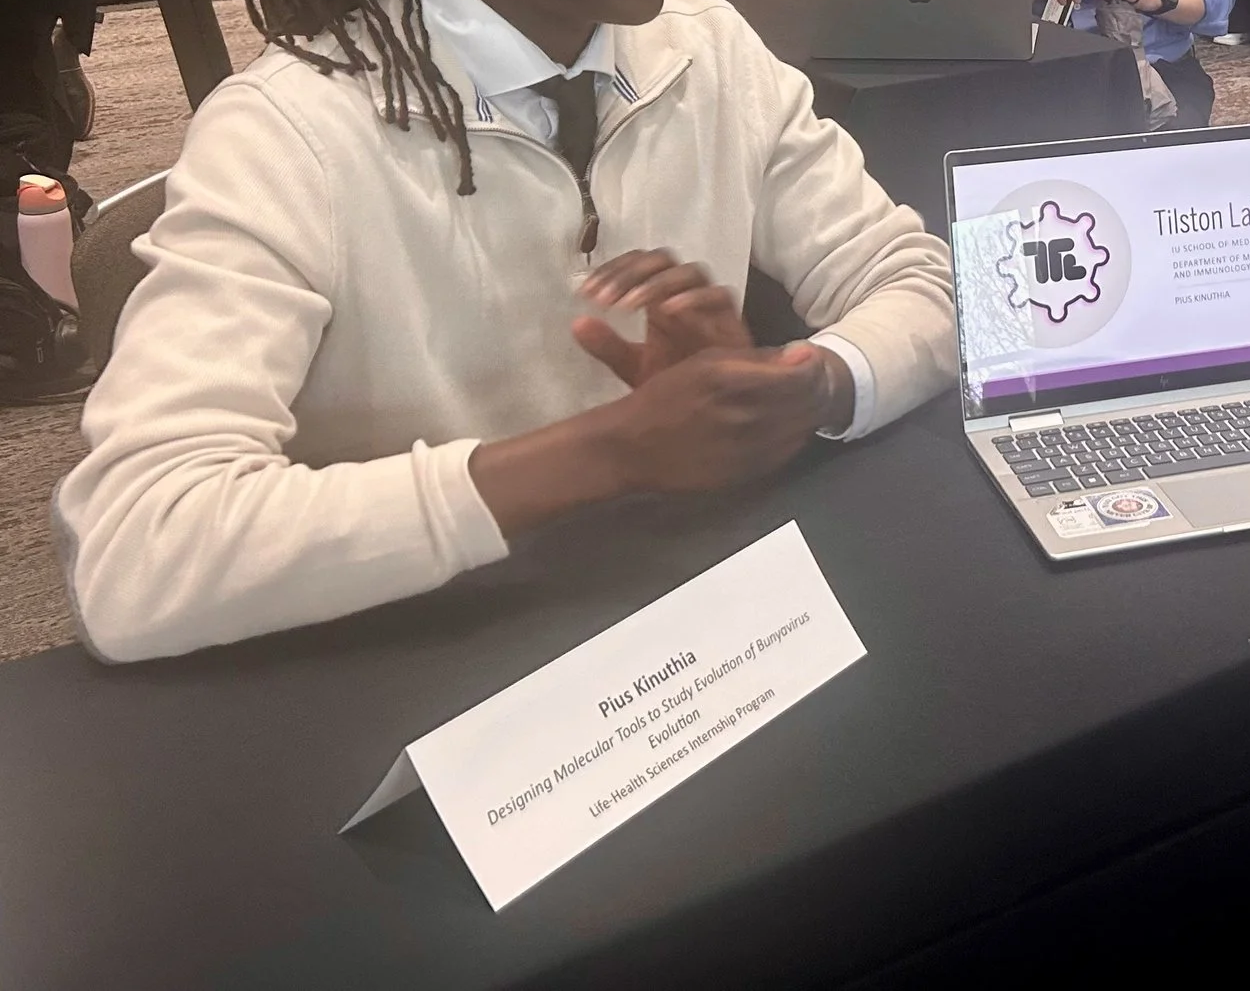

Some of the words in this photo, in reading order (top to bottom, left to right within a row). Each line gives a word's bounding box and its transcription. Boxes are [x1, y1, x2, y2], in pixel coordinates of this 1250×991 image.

[1153, 207, 1223, 236] Tilston
[1171, 245, 1181, 254] IU
[1183, 241, 1216, 253] SCHOOL
[1218, 240, 1228, 249] OF
[1172, 256, 1227, 270] DEPARTMENT
[1229, 254, 1240, 263] OF
[1173, 270, 1191, 280] AND
[1193, 263, 1250, 277] IMMUNOLOGY
[1174, 296, 1193, 305] PIUS
[1194, 290, 1231, 303] KINUTHIA
[598, 690, 634, 718] Pius
[633, 651, 697, 696] Kinuthia
[487, 777, 553, 825] Designing
[553, 736, 614, 784] Molecular
[615, 716, 647, 742] Tools
[647, 708, 661, 722] to
[661, 686, 693, 713] Study
[694, 654, 744, 693] Evolution
[745, 643, 757, 660] of
[756, 611, 810, 652] Bunyavirus
[648, 709, 701, 749] Evolution
[589, 774, 648, 818] Life-Health
[646, 746, 689, 780] Sciences
[688, 713, 737, 751] Internship
[735, 688, 775, 719] Program
